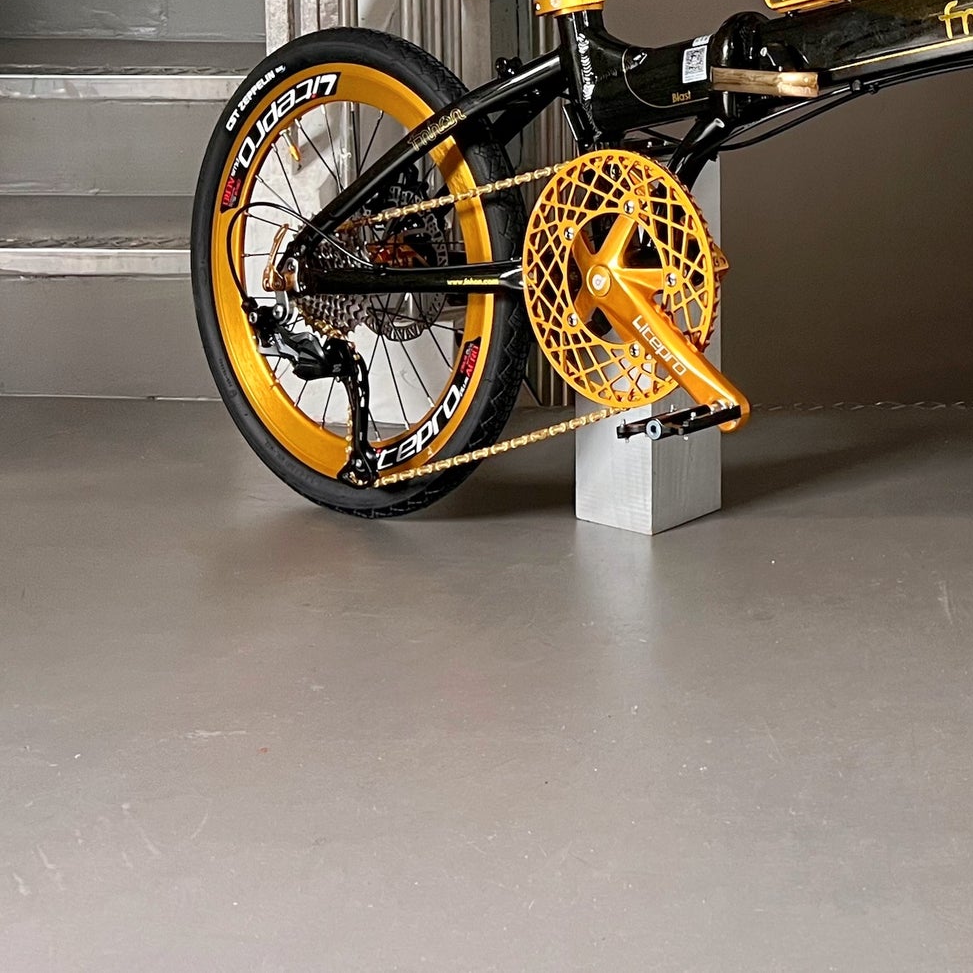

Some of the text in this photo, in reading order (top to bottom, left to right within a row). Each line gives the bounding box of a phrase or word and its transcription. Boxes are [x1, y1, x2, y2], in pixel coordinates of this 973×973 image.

[225, 69, 276, 132] CST ZEPPELIN
[671, 90, 692, 103] Blast
[376, 384, 461, 470] tepro
